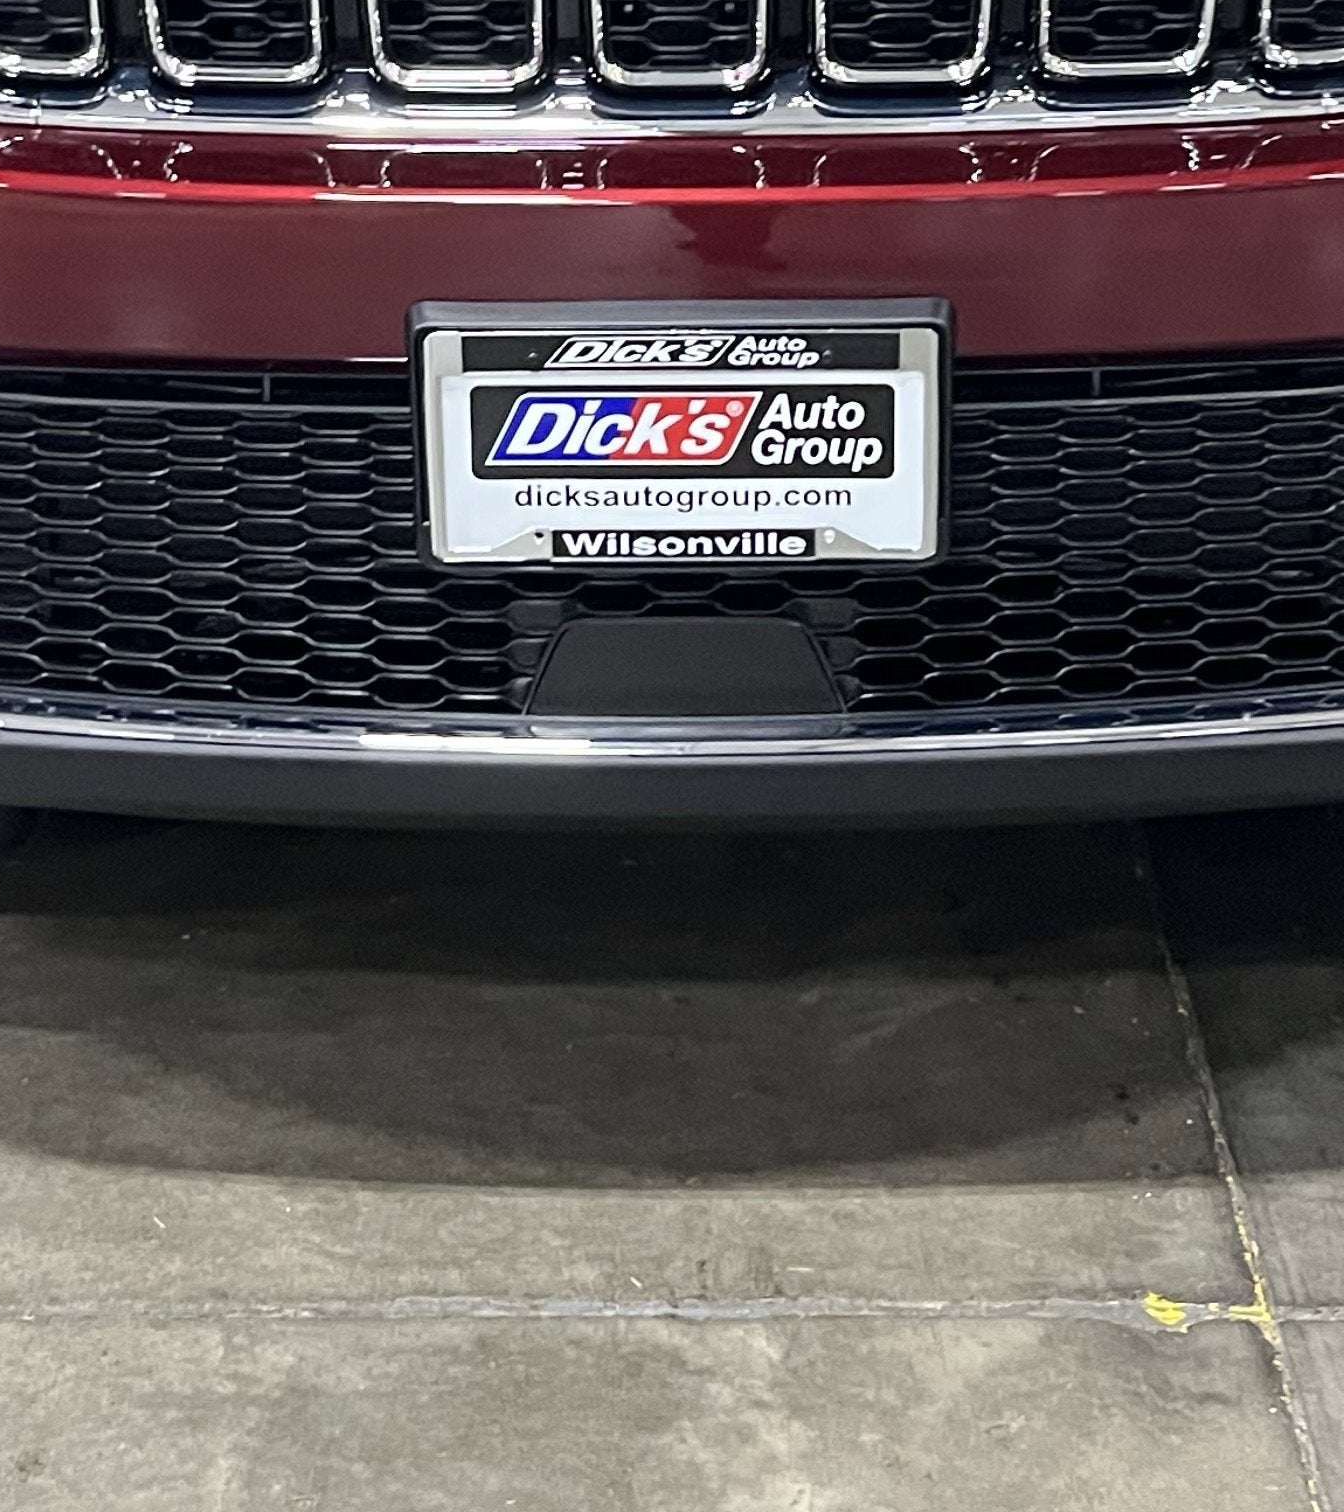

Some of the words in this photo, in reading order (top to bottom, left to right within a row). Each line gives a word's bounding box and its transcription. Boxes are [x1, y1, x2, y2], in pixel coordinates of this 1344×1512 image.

[732, 335, 808, 352] Auto
[727, 349, 821, 369] Group
[759, 392, 866, 431] Auto
[750, 432, 884, 473] Group
[514, 485, 853, 513] dicksautogroup.com
[561, 531, 808, 557] Wilsonville
